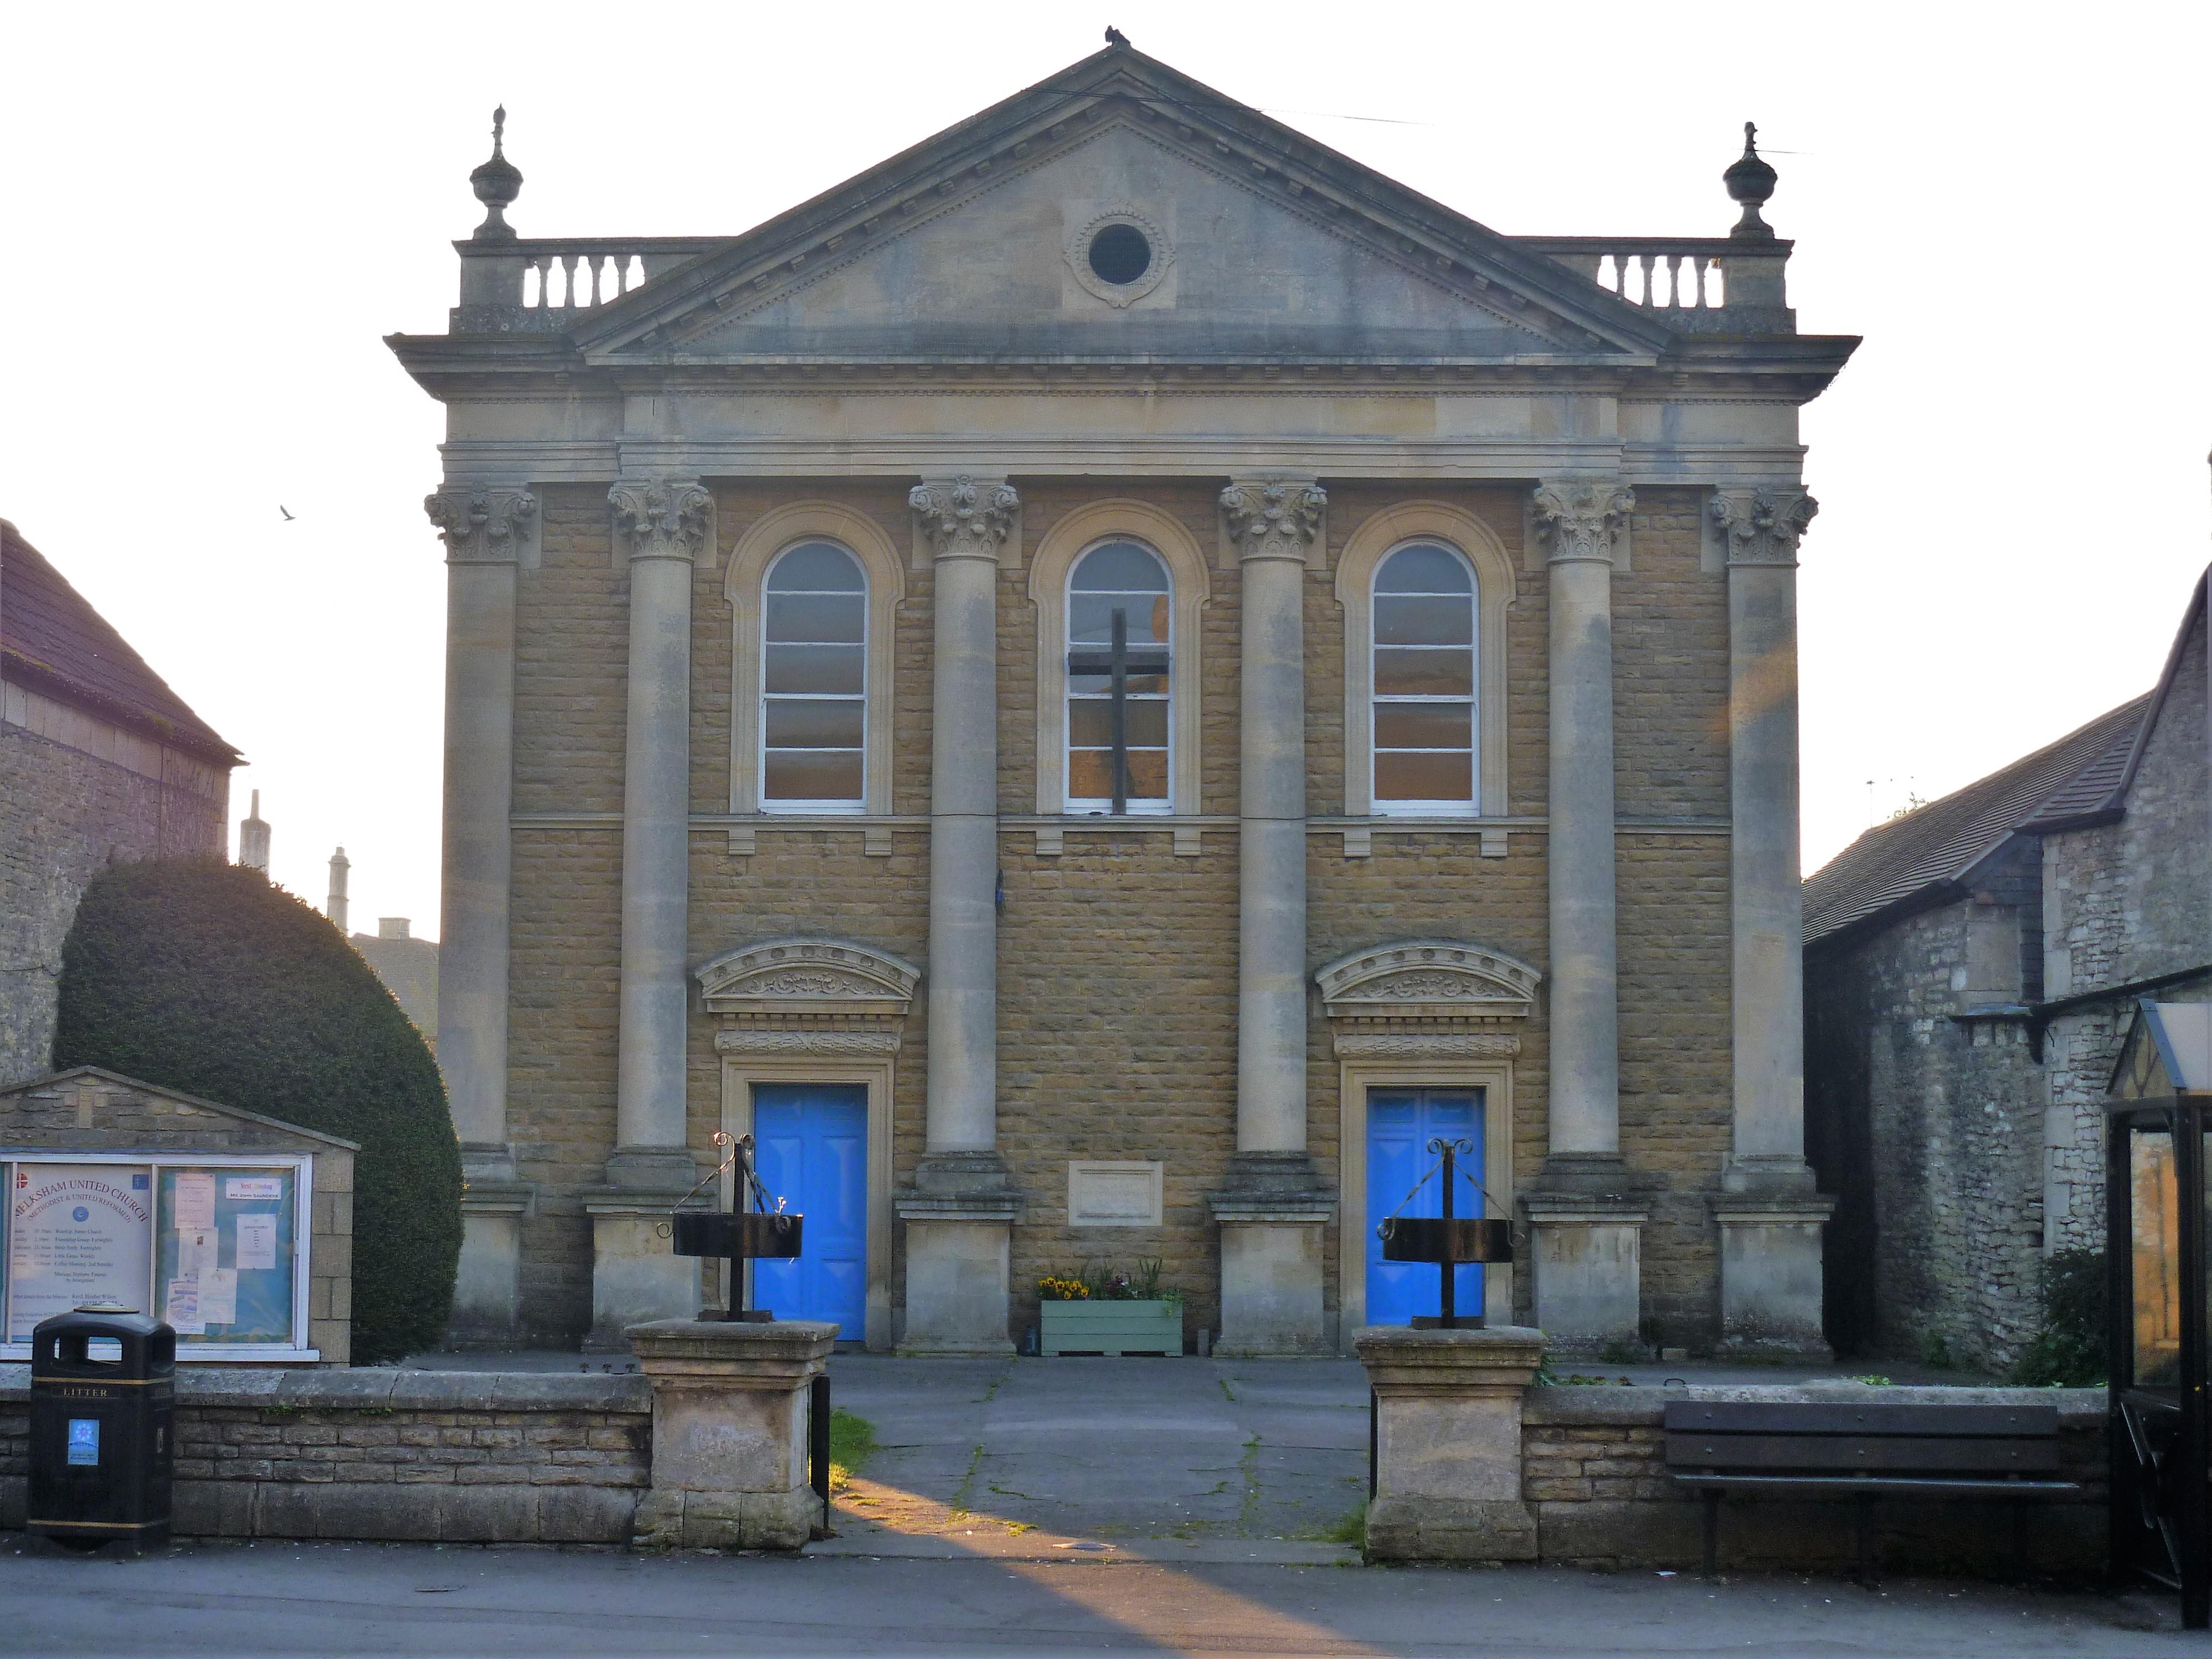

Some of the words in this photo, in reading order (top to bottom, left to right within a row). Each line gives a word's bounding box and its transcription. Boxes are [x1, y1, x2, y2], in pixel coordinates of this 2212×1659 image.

[15, 1181, 66, 1218] MELKSHAM
[70, 1180, 110, 1193] UNITED
[111, 1188, 148, 1222] CHURCH
[28, 1194, 63, 1222] (METHODIST
[63, 1388, 107, 1397] LITTER
